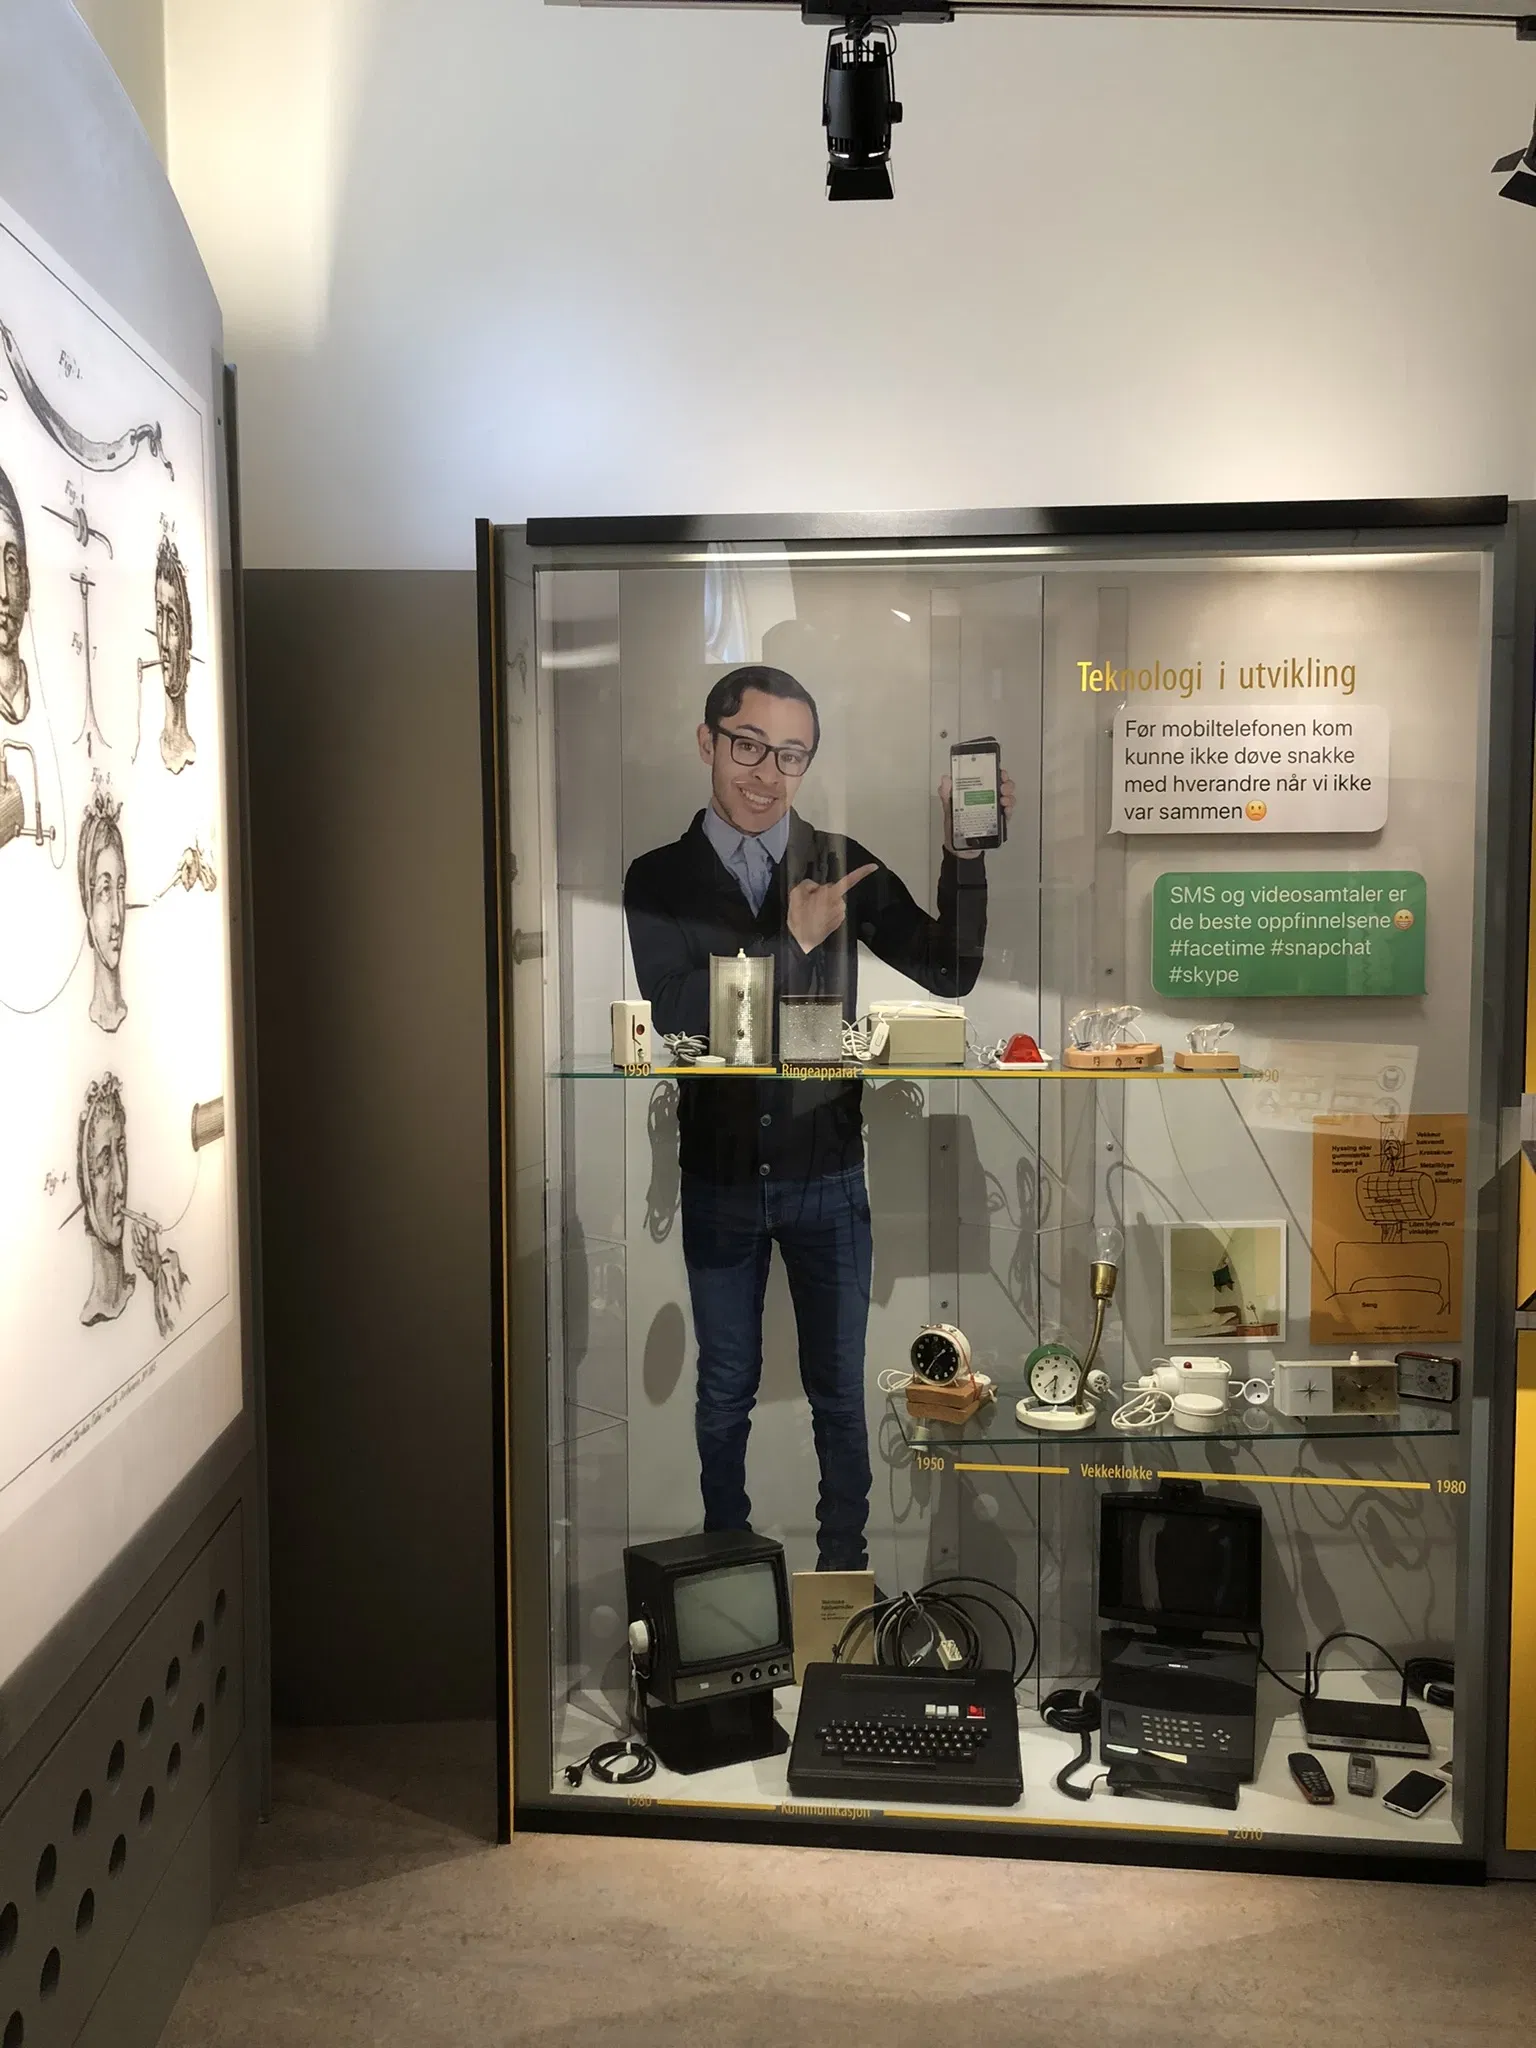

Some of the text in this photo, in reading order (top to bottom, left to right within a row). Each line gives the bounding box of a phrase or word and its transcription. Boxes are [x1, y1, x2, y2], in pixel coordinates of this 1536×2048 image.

[1077, 657, 1358, 698] Teknologi i utvikling
[1125, 718, 1354, 738] Før mobiltelefonen kom
[1124, 746, 1356, 765] kunne ikke døve snakke
[1124, 773, 1373, 793] med hverandre når vi ikke
[1123, 804, 1243, 820] var sammen
[1169, 885, 1407, 907] SMS og videosamtaler er
[1169, 911, 1392, 934] de beste oppfinnelsene
[1169, 937, 1372, 959] #facetime #snapchat
[1168, 965, 1240, 986] #skype
[622, 1063, 650, 1077] 1950
[782, 1063, 859, 1081] Ringeapparat
[916, 1456, 1467, 1495] 1950 Vekkeklokke 1980
[782, 1803, 871, 1820] Kommunikasjon
